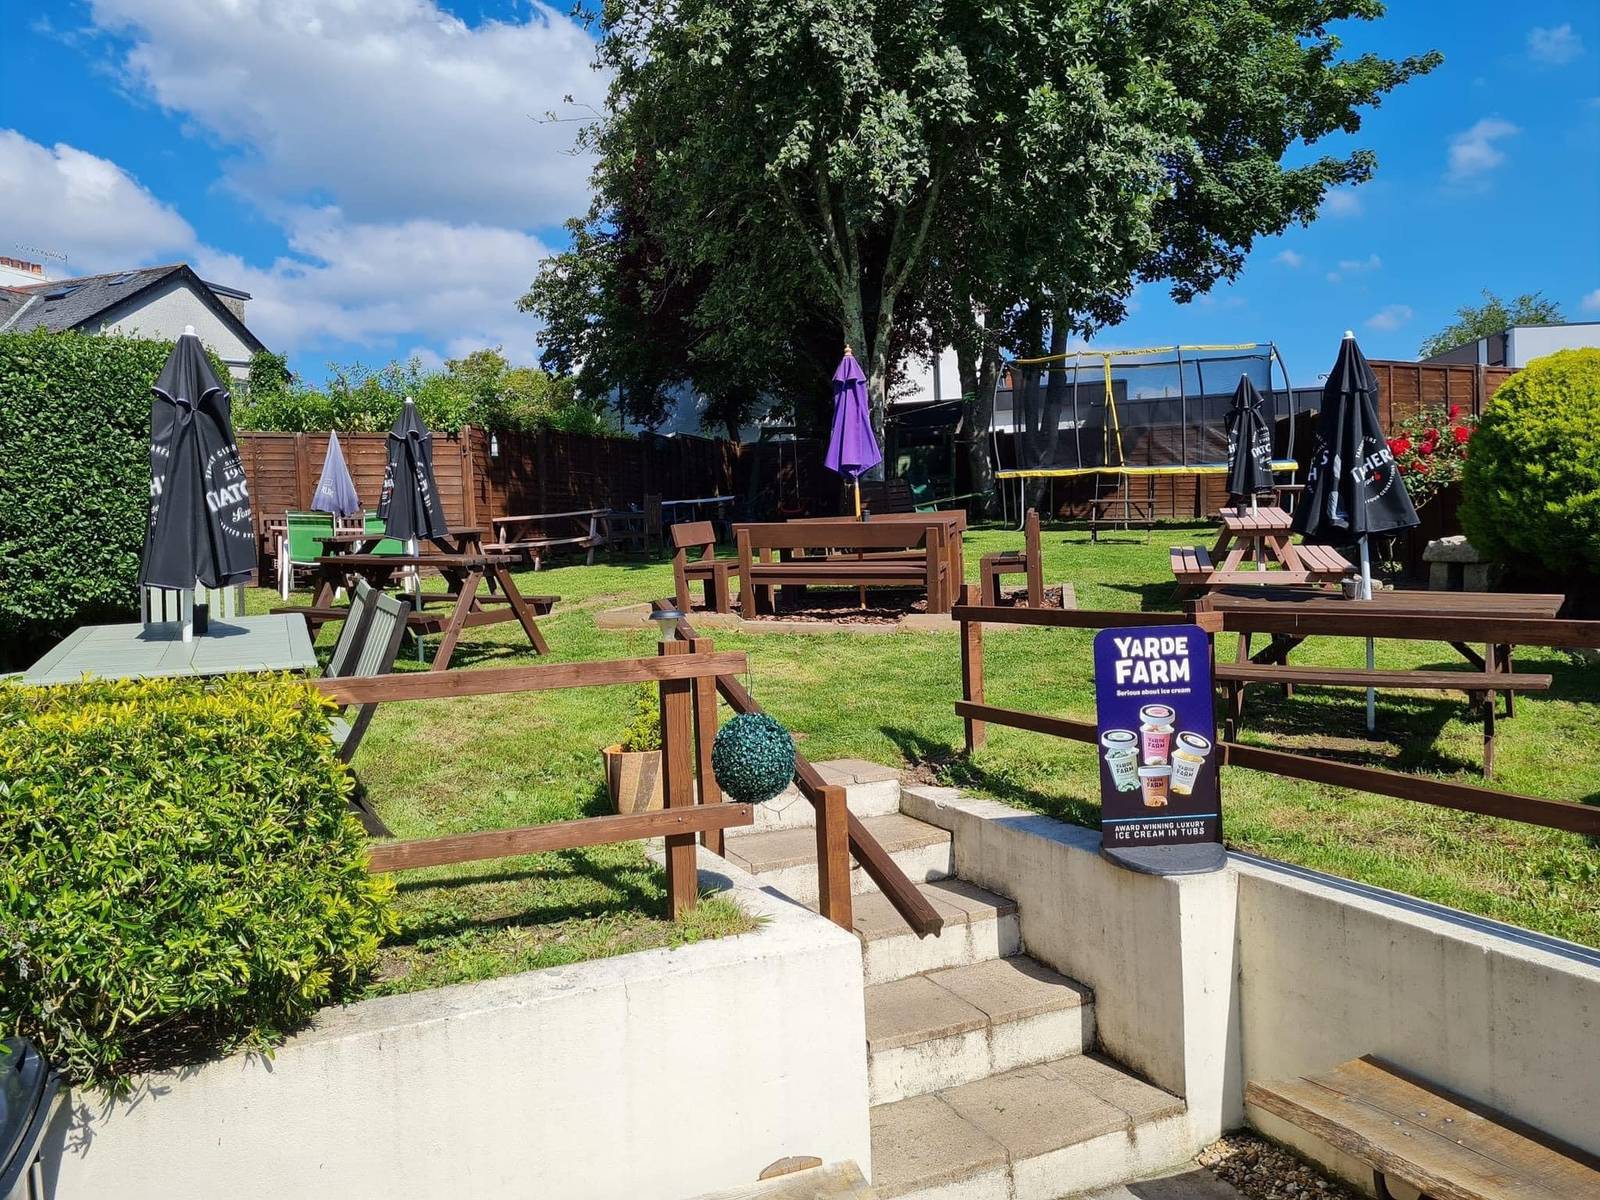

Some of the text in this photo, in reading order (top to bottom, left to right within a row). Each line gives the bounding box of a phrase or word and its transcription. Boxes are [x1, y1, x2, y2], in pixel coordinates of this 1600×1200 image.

[1113, 636, 1189, 659] YARDE
[1115, 658, 1191, 685] FARM
[1116, 689, 1141, 697] Serious
[1141, 688, 1160, 696] about
[1116, 766, 1134, 774] FARM
[1114, 824, 1140, 832] AWARD
[1142, 822, 1174, 830] WINNING
[1115, 827, 1205, 840] ICE CREAM IN TUBS
